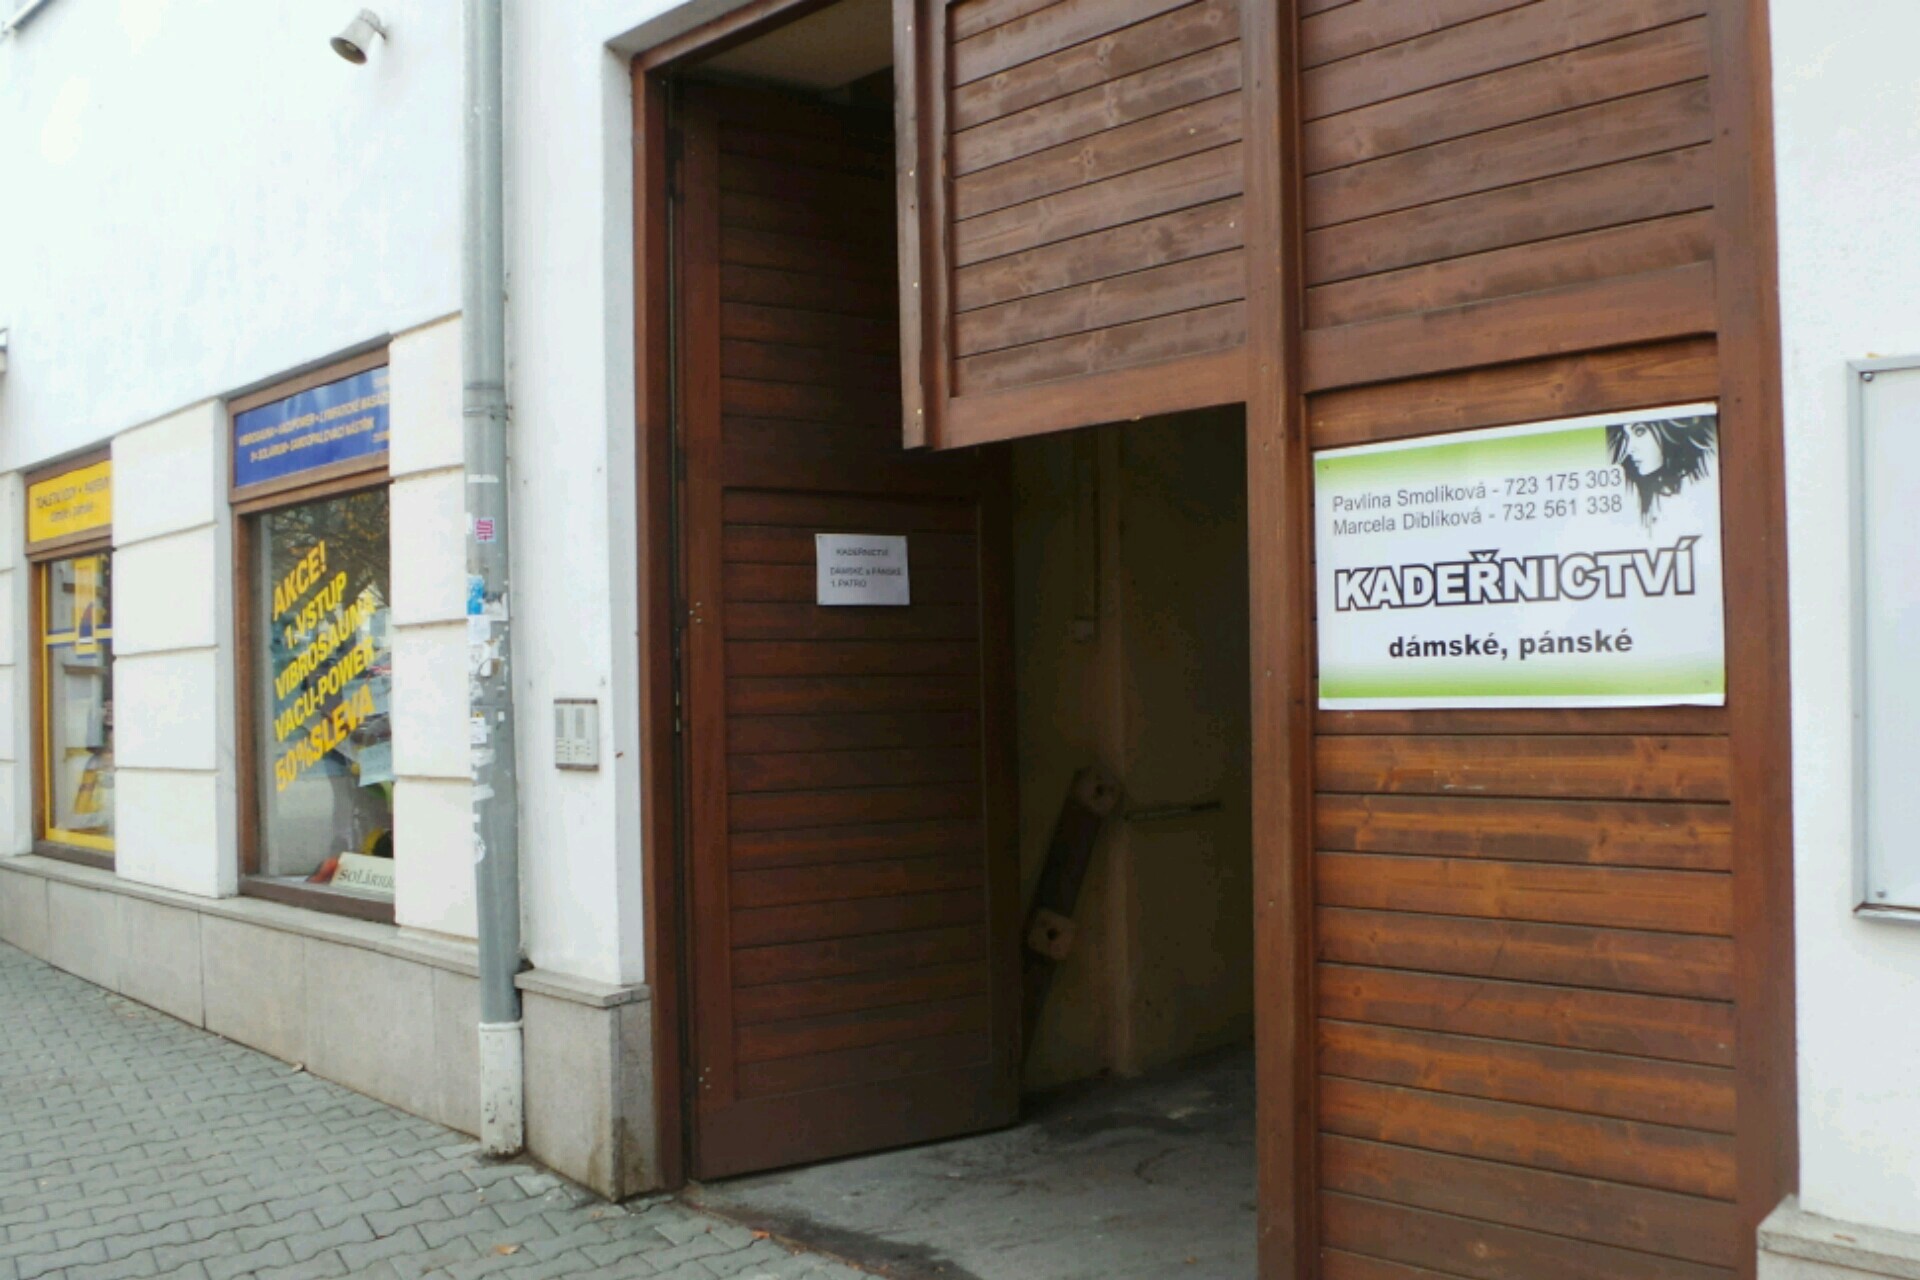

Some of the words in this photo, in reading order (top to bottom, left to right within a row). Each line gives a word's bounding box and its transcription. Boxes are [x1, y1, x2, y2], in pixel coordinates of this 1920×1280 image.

[1332, 491, 1392, 513] Pavlína
[1397, 482, 1487, 507] Smolíková
[1504, 477, 1539, 496] 723
[1547, 472, 1580, 492] 175
[1585, 468, 1622, 489] 303
[1333, 516, 1396, 536] Marcela
[1502, 502, 1536, 522] 732
[1543, 498, 1578, 518] 561
[1586, 494, 1623, 515] 338
[273, 540, 327, 621] AKCE!
[1334, 535, 1702, 612] KADEŘNICTVÍ
[275, 591, 376, 701] VIBROSAUNA
[1389, 634, 1508, 660] dámské,
[1519, 629, 1633, 660] pánské
[274, 636, 375, 743] VACU-POWER
